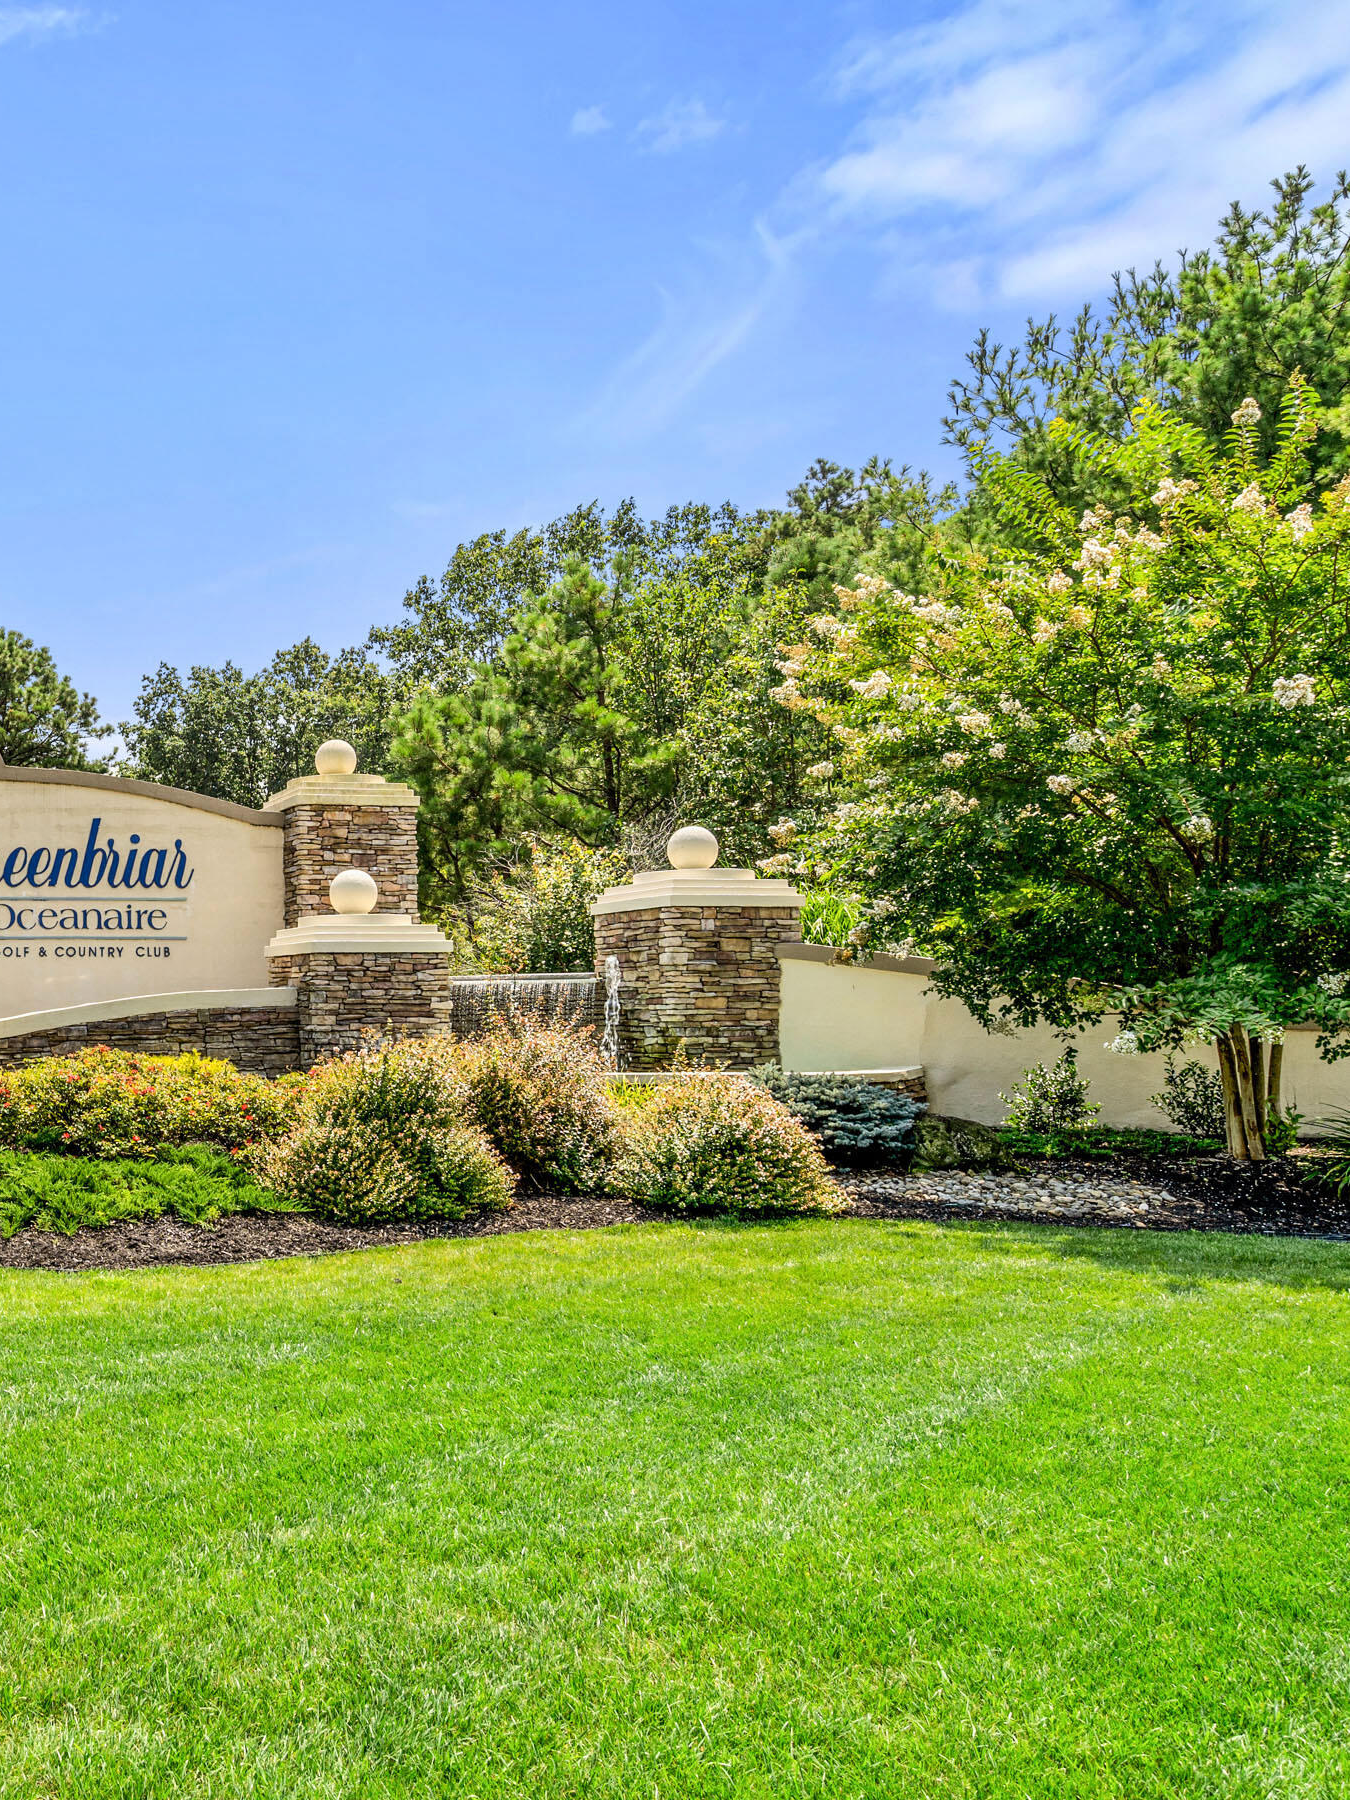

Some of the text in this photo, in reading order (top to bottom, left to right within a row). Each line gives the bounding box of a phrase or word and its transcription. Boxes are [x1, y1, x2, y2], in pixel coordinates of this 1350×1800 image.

[38, 946, 48, 958] &
[54, 946, 125, 958] COUNTRY
[135, 946, 171, 958] CLUB
